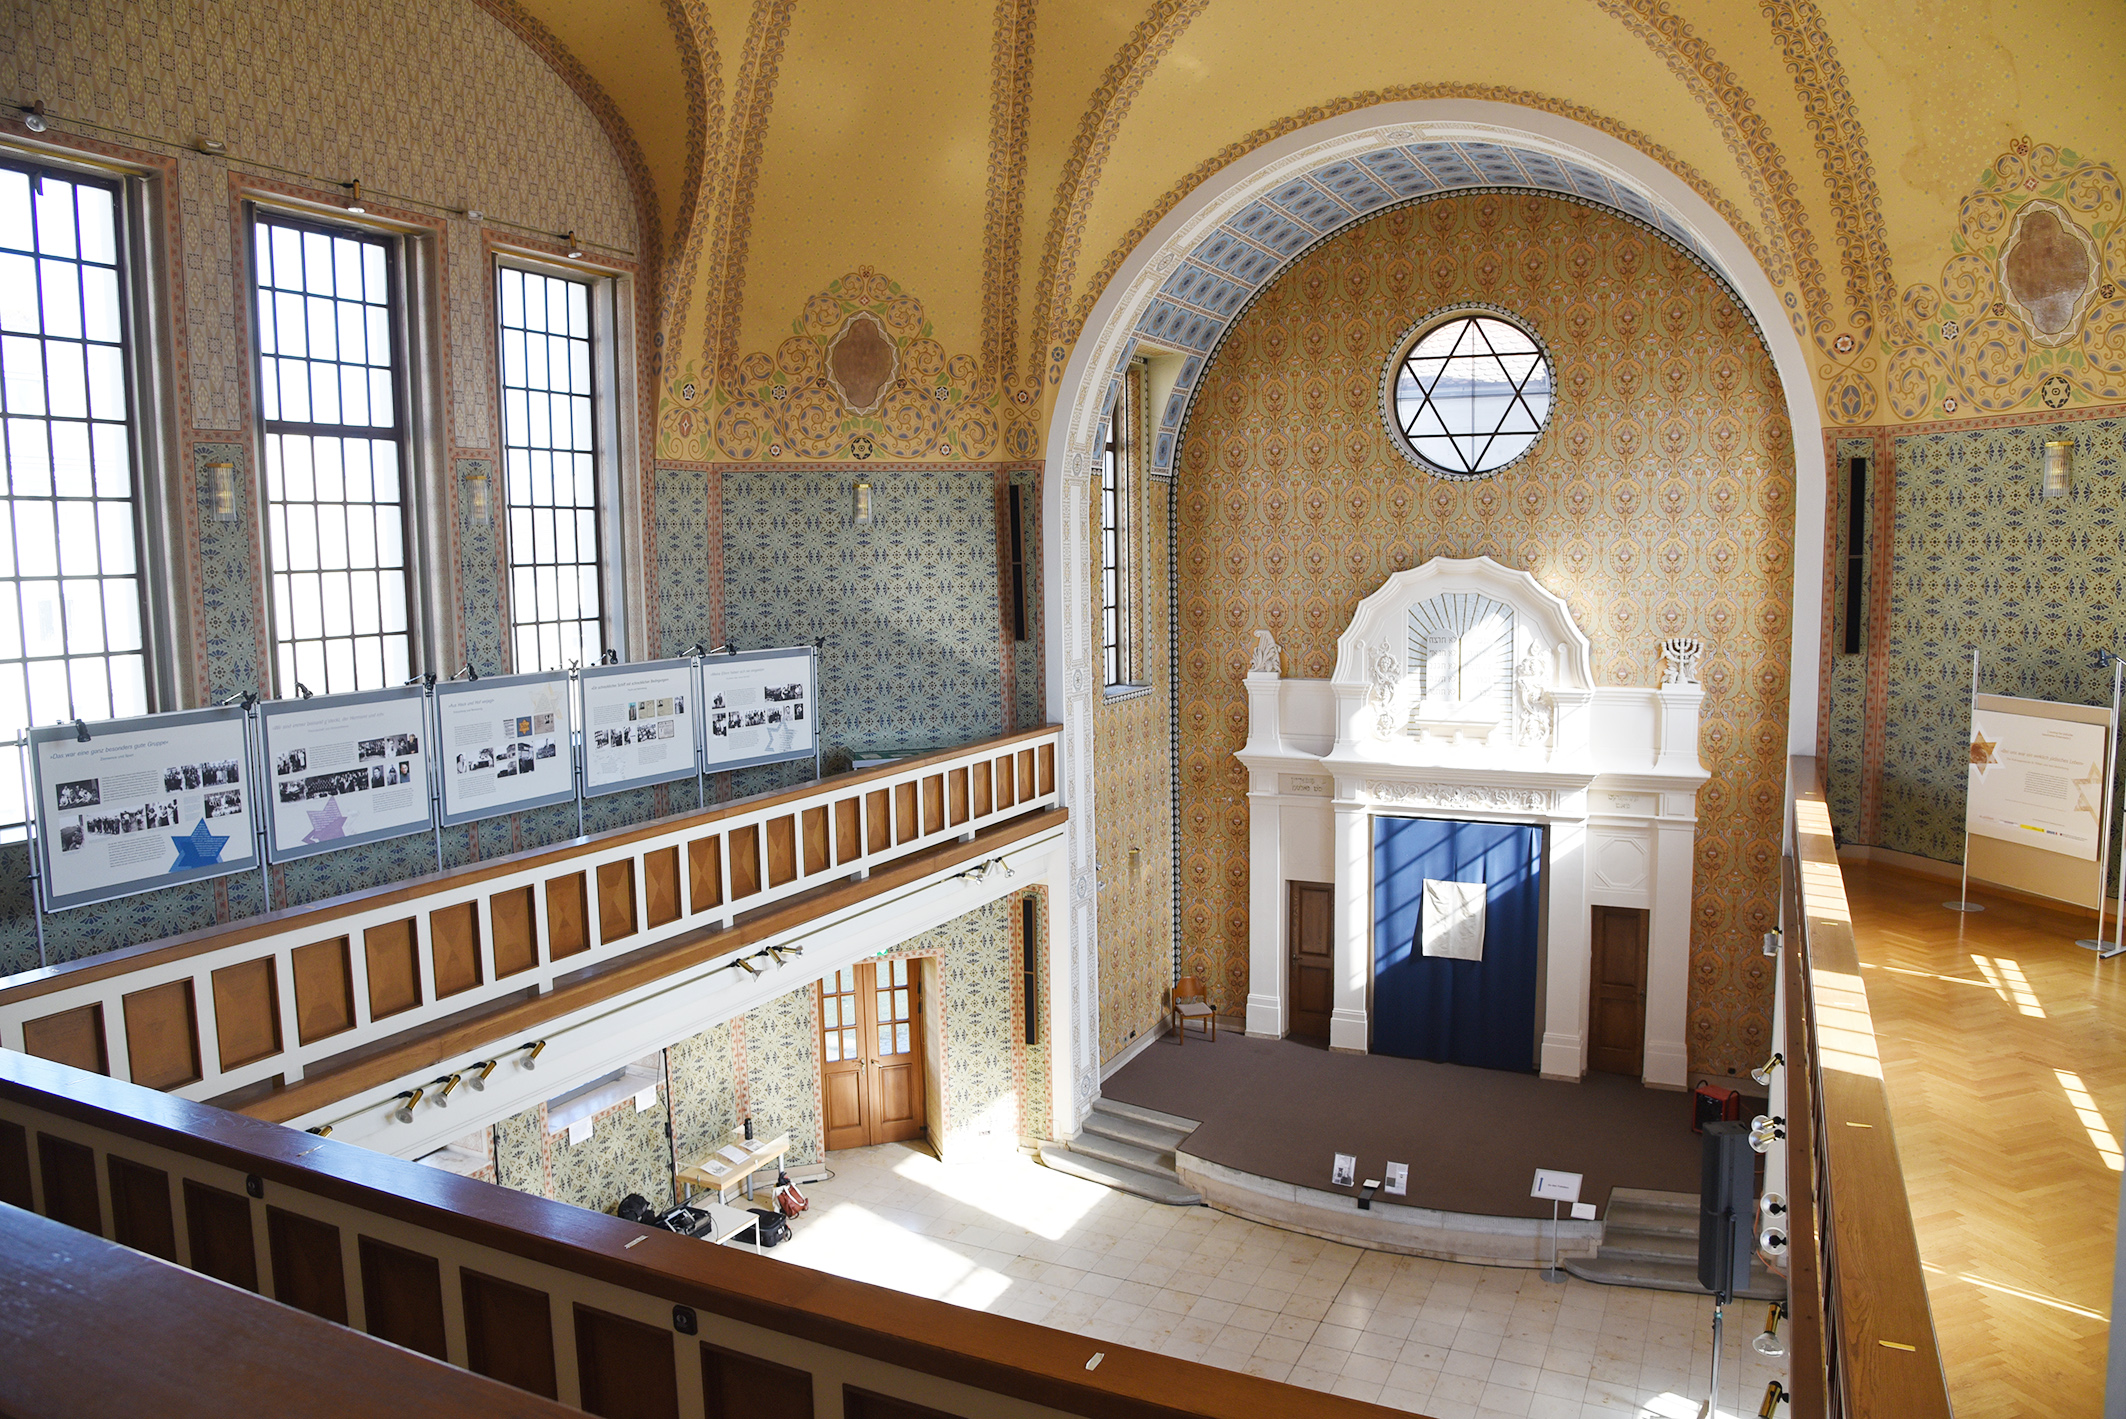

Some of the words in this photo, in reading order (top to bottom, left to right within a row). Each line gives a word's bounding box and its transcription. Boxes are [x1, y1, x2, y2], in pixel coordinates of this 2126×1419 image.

[1448, 636, 1457, 644] לא
[1448, 648, 1456, 657] לא
[1448, 661, 1456, 670] לא
